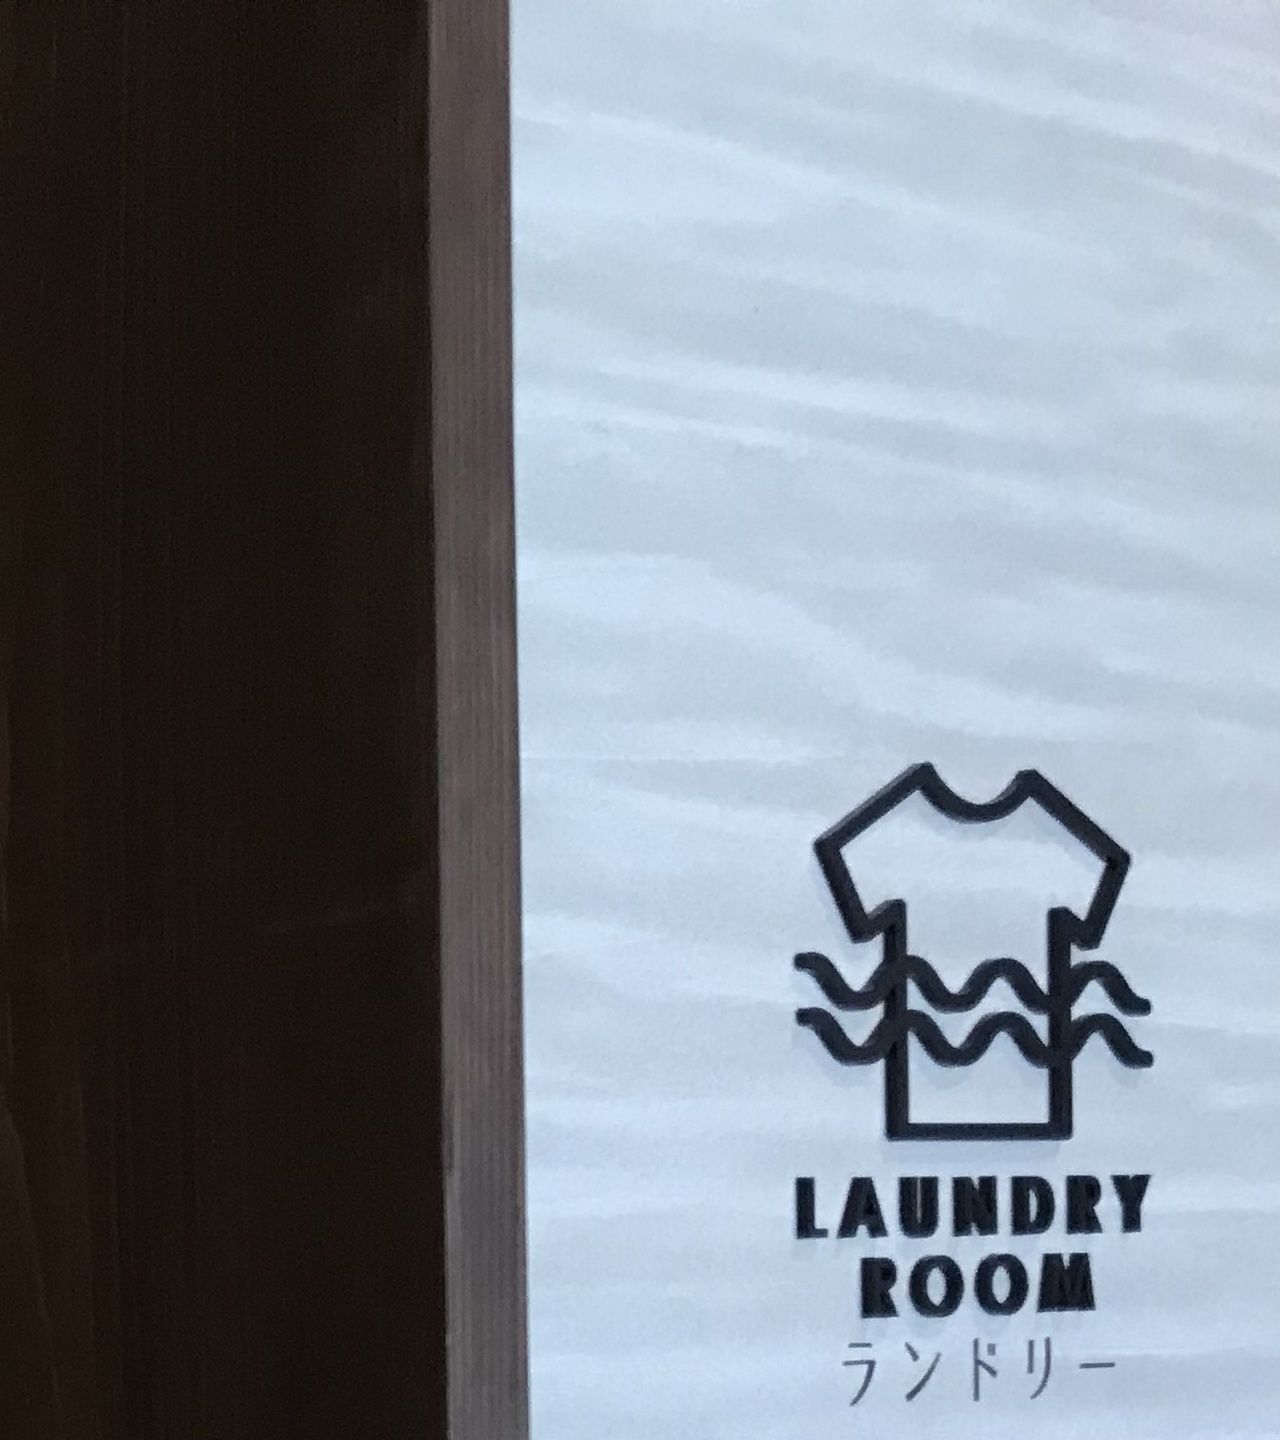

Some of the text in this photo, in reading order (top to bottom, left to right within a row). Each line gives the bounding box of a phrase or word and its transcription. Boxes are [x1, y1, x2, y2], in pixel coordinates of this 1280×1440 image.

[793, 1173, 1153, 1240] LAUNDRY
[859, 1251, 1096, 1319] ROOM
[841, 1336, 1116, 1407] ランドリー
